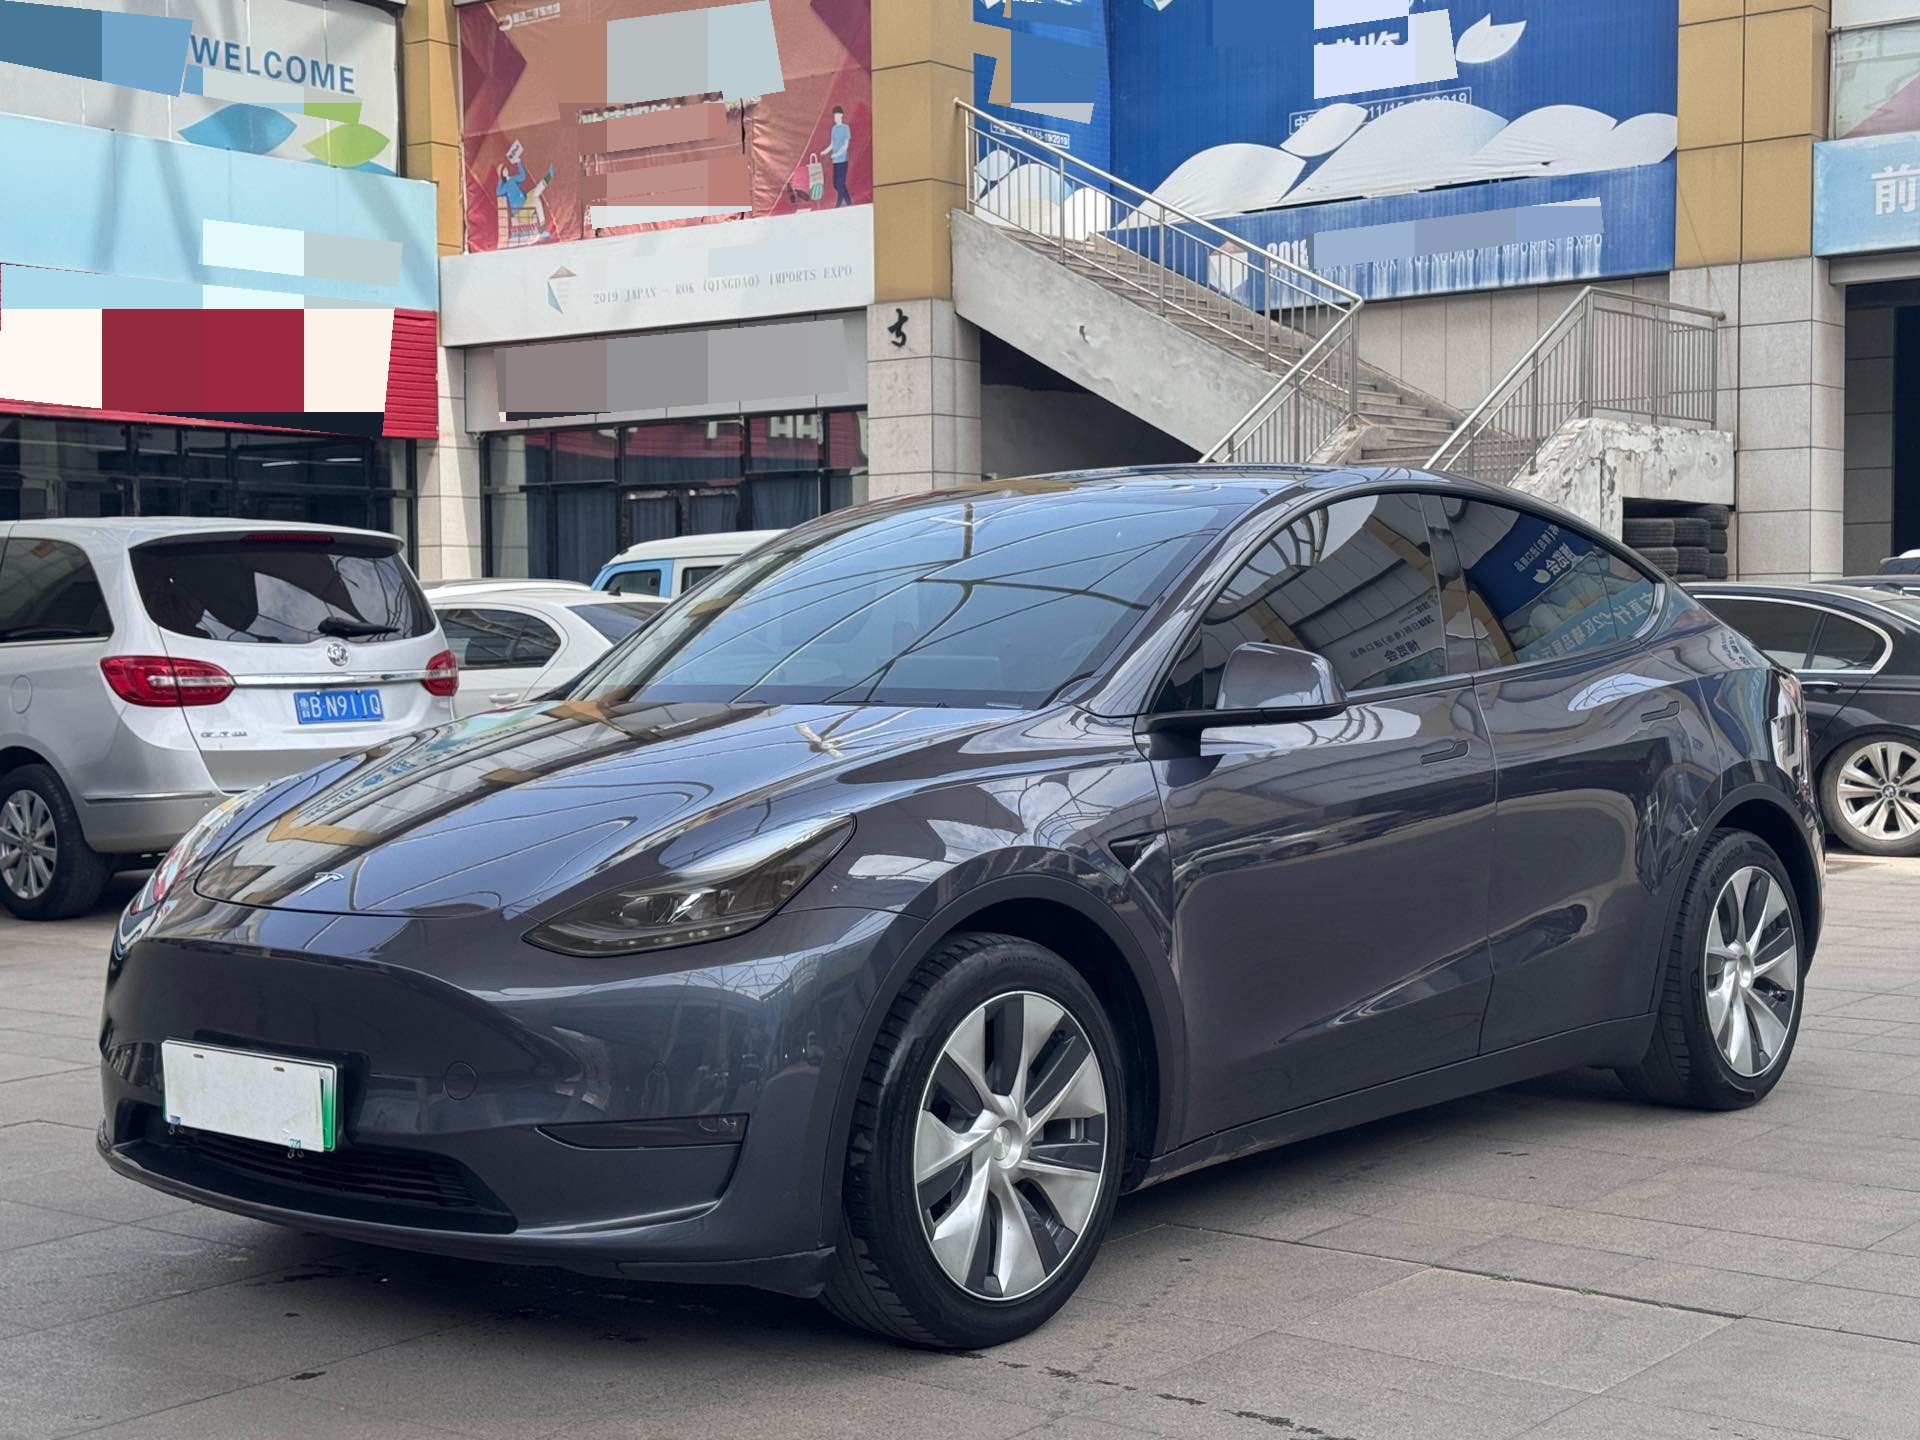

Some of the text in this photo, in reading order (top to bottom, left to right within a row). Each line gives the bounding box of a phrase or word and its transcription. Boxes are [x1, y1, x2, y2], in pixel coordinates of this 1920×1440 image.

[191, 34, 355, 94] WELCOME
[1871, 164, 1920, 215] 前
[624, 285, 656, 302] JAPAN
[769, 268, 816, 286] IMPORTS
[823, 264, 852, 279] EXPO
